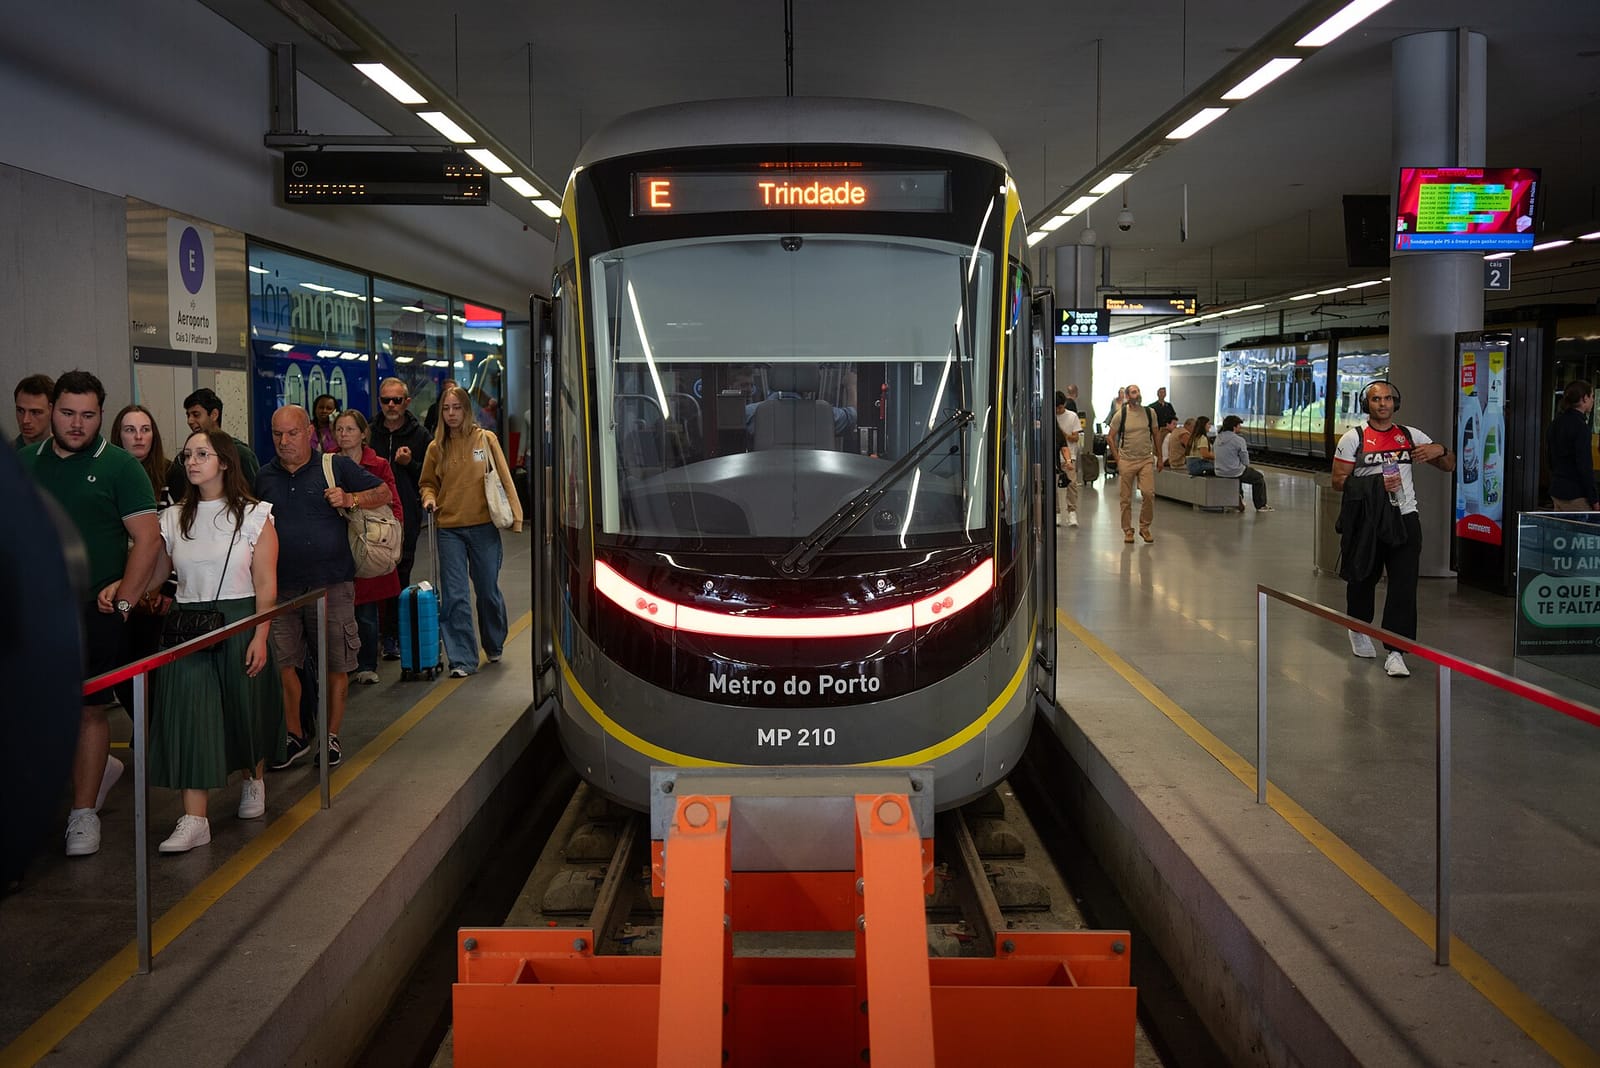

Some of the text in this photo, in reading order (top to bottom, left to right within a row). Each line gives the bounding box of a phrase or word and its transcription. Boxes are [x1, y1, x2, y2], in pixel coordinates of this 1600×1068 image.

[650, 181, 866, 208] E Trindade
[189, 250, 195, 272] E
[1490, 270, 1501, 287] 2
[291, 285, 360, 335] andante
[177, 310, 209, 330] Aeroporto
[175, 331, 185, 342] Cais
[191, 333, 208, 344] Platform
[1553, 537, 1567, 550] O
[1552, 557, 1572, 569] TU
[1538, 586, 1552, 598] O
[1557, 585, 1591, 598] QUE
[1537, 601, 1600, 614] TE FALTA
[709, 673, 881, 695] Metro do Porto
[757, 727, 836, 746] MP 210
